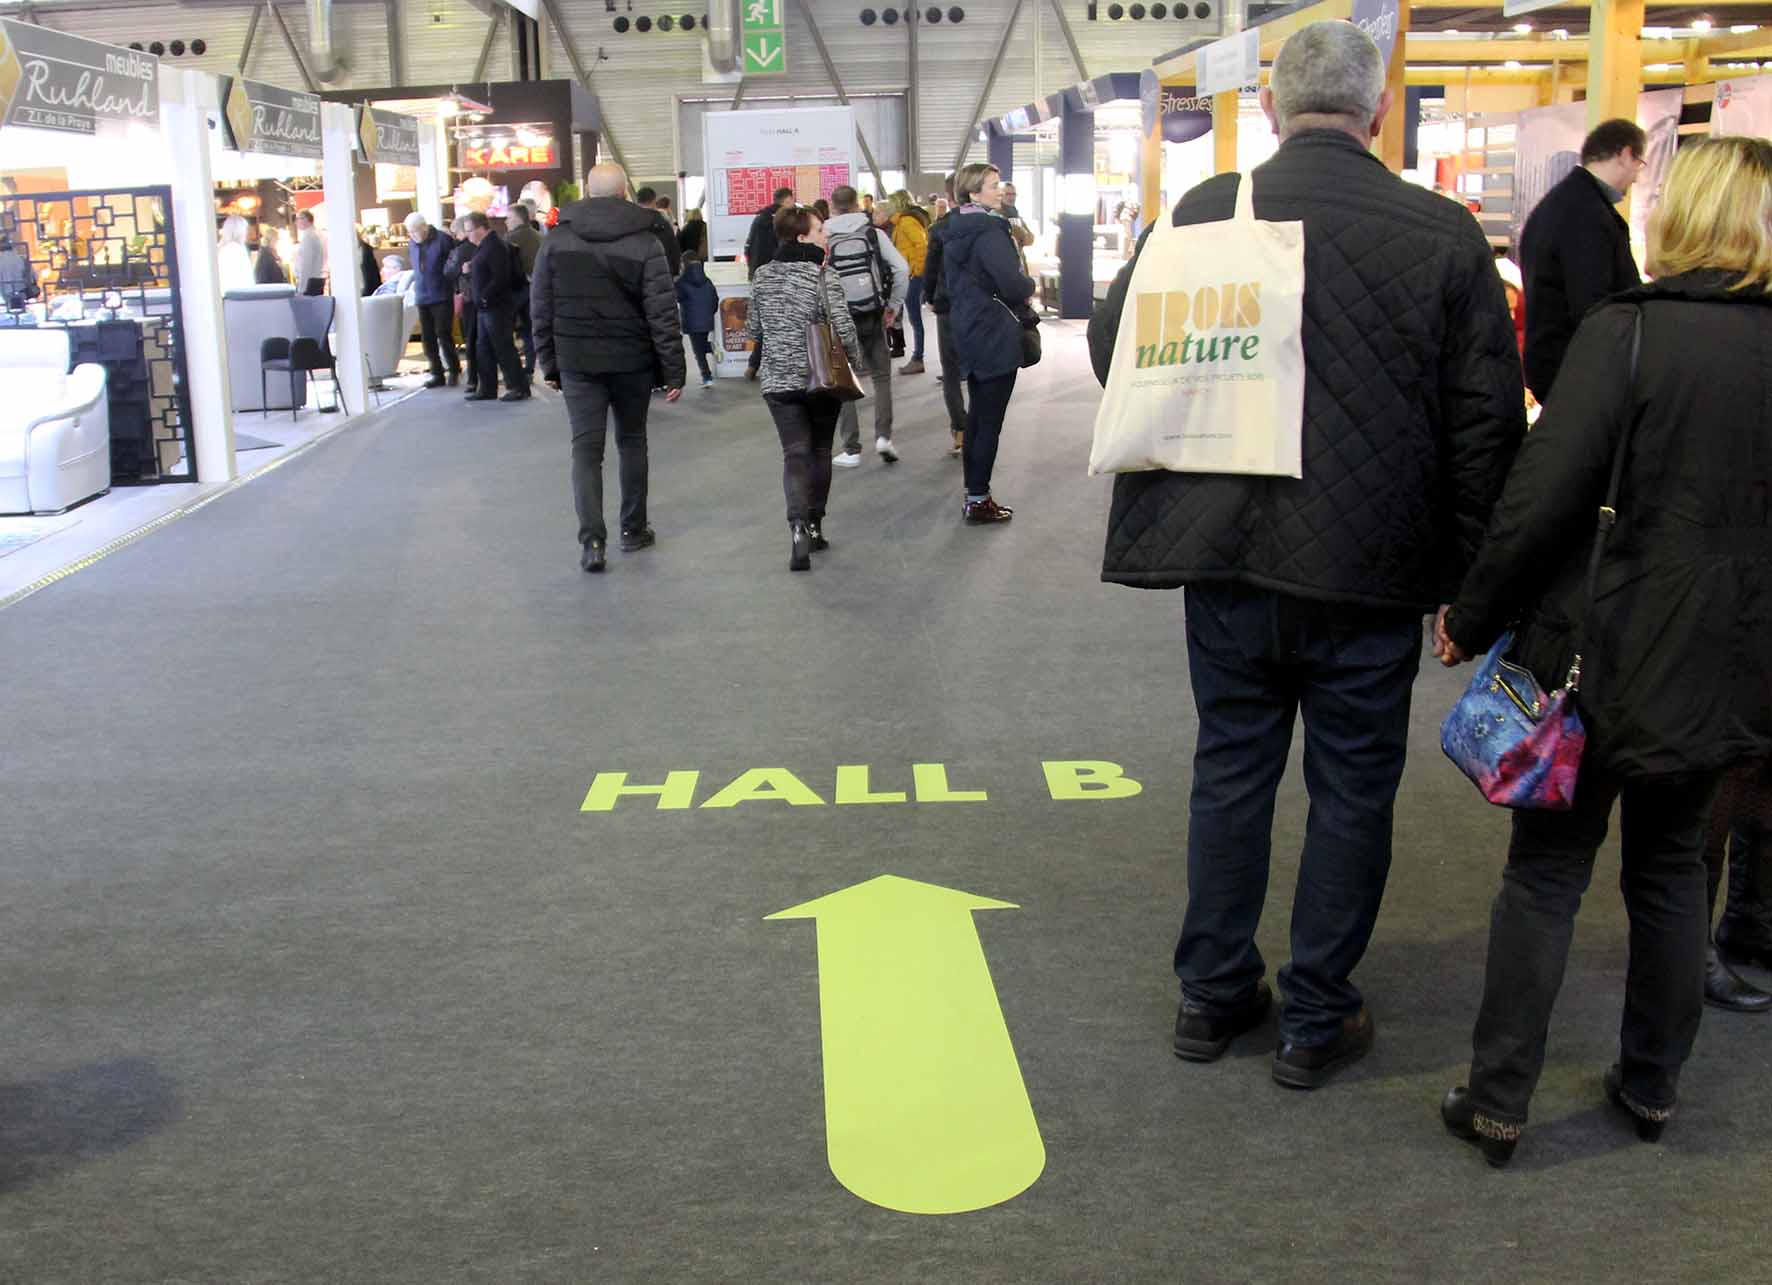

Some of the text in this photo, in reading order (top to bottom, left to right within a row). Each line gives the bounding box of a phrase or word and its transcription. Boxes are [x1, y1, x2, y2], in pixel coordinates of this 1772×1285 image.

[106, 53, 153, 81] meubles
[24, 60, 155, 117] Ruhland
[253, 105, 320, 142] Ruhland
[1135, 333, 1260, 369] nature
[580, 760, 1143, 811] HALL B
